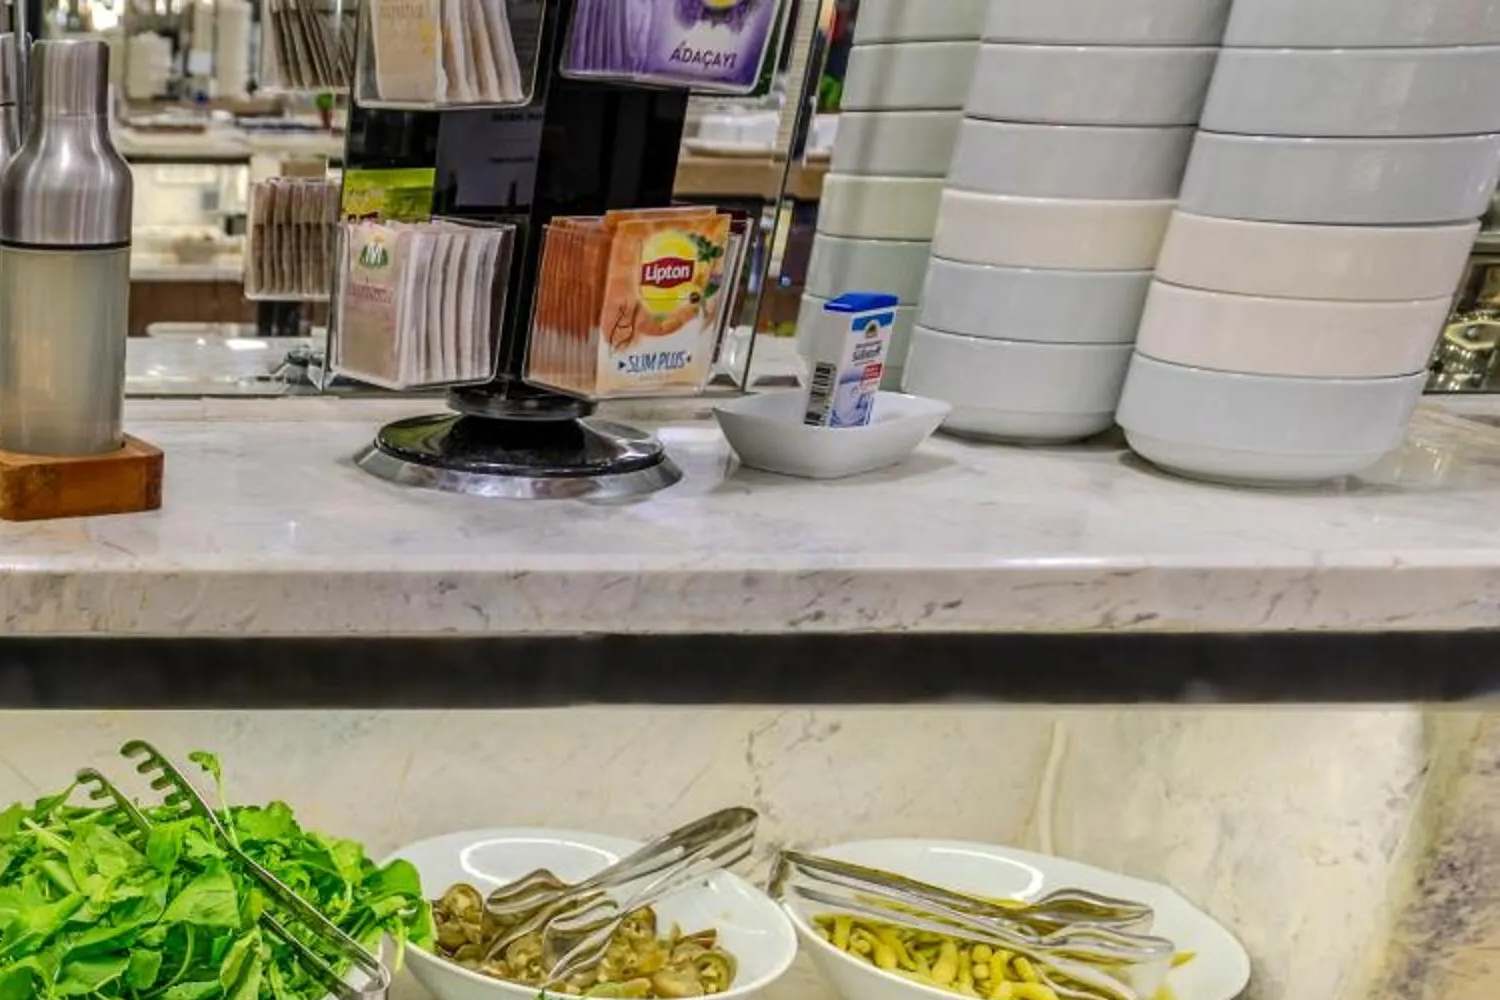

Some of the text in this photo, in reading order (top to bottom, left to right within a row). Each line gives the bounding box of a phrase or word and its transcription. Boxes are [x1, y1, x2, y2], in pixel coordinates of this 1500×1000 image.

[644, 265, 690, 285] Lipton
[626, 350, 687, 373] SLIM PLUS
